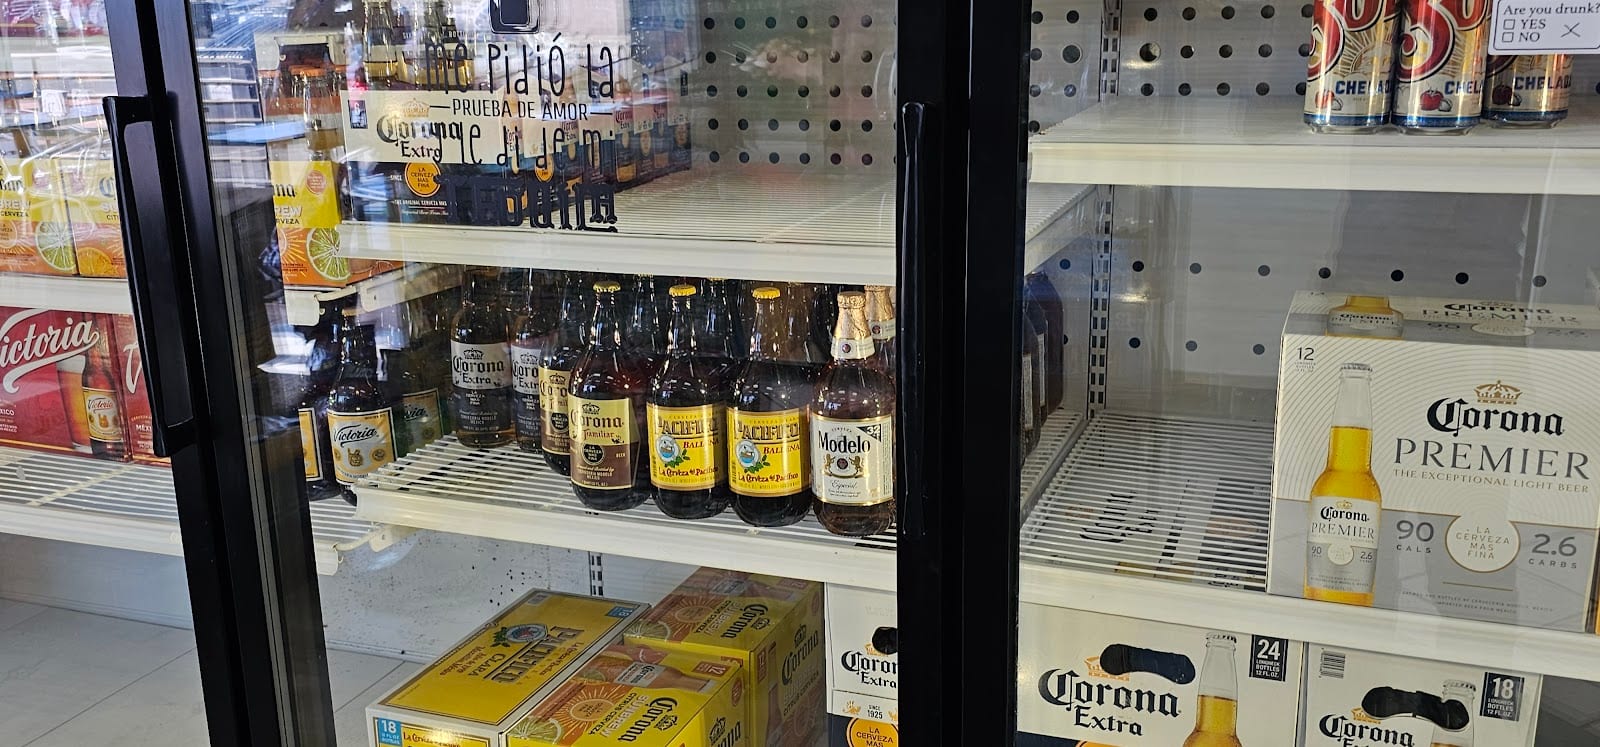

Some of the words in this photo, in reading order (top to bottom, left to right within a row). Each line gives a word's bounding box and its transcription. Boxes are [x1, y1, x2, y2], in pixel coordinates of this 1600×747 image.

[1503, 5, 1526, 15] Are
[1529, 7, 1551, 18] you
[1555, 3, 1600, 15] drunk?
[1521, 19, 1546, 29] YES
[1519, 32, 1540, 42] NO
[1514, 75, 1572, 91] CHELAD
[452, 99, 512, 119] PRUEBA
[519, 101, 536, 119] DE
[542, 102, 588, 121] AMOR
[377, 115, 462, 147] Corona
[496, 126, 521, 169] di
[536, 127, 567, 170] de
[436, 174, 618, 232] TEQUILA
[1444, 303, 1552, 314] Corona
[1297, 347, 1315, 361] 12
[453, 355, 504, 376] Corona
[463, 373, 491, 384] Extra
[88, 397, 114, 413] Victoria
[570, 408, 625, 428] Corona
[1427, 397, 1564, 437] Corona
[334, 424, 379, 447] Victoria
[867, 424, 881, 434] 32
[818, 430, 871, 453] Modelo
[1394, 437, 1591, 480] PREMIER
[1393, 469, 1417, 479] THE
[1421, 470, 1509, 487] EXCEPTIONAL
[1513, 479, 1552, 490] LIGHT
[1557, 482, 1589, 493] BEER
[1320, 505, 1369, 521] Corona
[1311, 522, 1375, 539] PREMIER
[1396, 520, 1434, 542] 90
[1456, 533, 1510, 546] CERVEZA
[1476, 526, 1491, 534] LA
[1311, 546, 1322, 555] 90
[1396, 545, 1432, 554] CALS
[1470, 542, 1495, 552] MAS
[1531, 533, 1577, 557] 2.6
[1360, 551, 1373, 560] 2.6
[1467, 551, 1495, 560] FINA
[1528, 558, 1577, 569] CARBS
[721, 602, 770, 640] Corona
[490, 625, 585, 684] PACIFICO
[782, 629, 819, 686] Corona
[1257, 638, 1281, 661] 24
[467, 652, 508, 677] CLARA
[1255, 664, 1280, 673] BOTTLES
[861, 671, 897, 689] Extra
[1493, 677, 1514, 700] 18
[613, 692, 638, 713] CITRUS
[1038, 668, 1181, 718] Corona
[588, 711, 617, 735] CERVEZA
[617, 696, 678, 742] Corona
[867, 710, 883, 720] 1925
[1074, 704, 1143, 736] Extra
[381, 719, 397, 734] 18
[1319, 713, 1413, 747] Corona
[856, 731, 893, 744] CERVEZA
